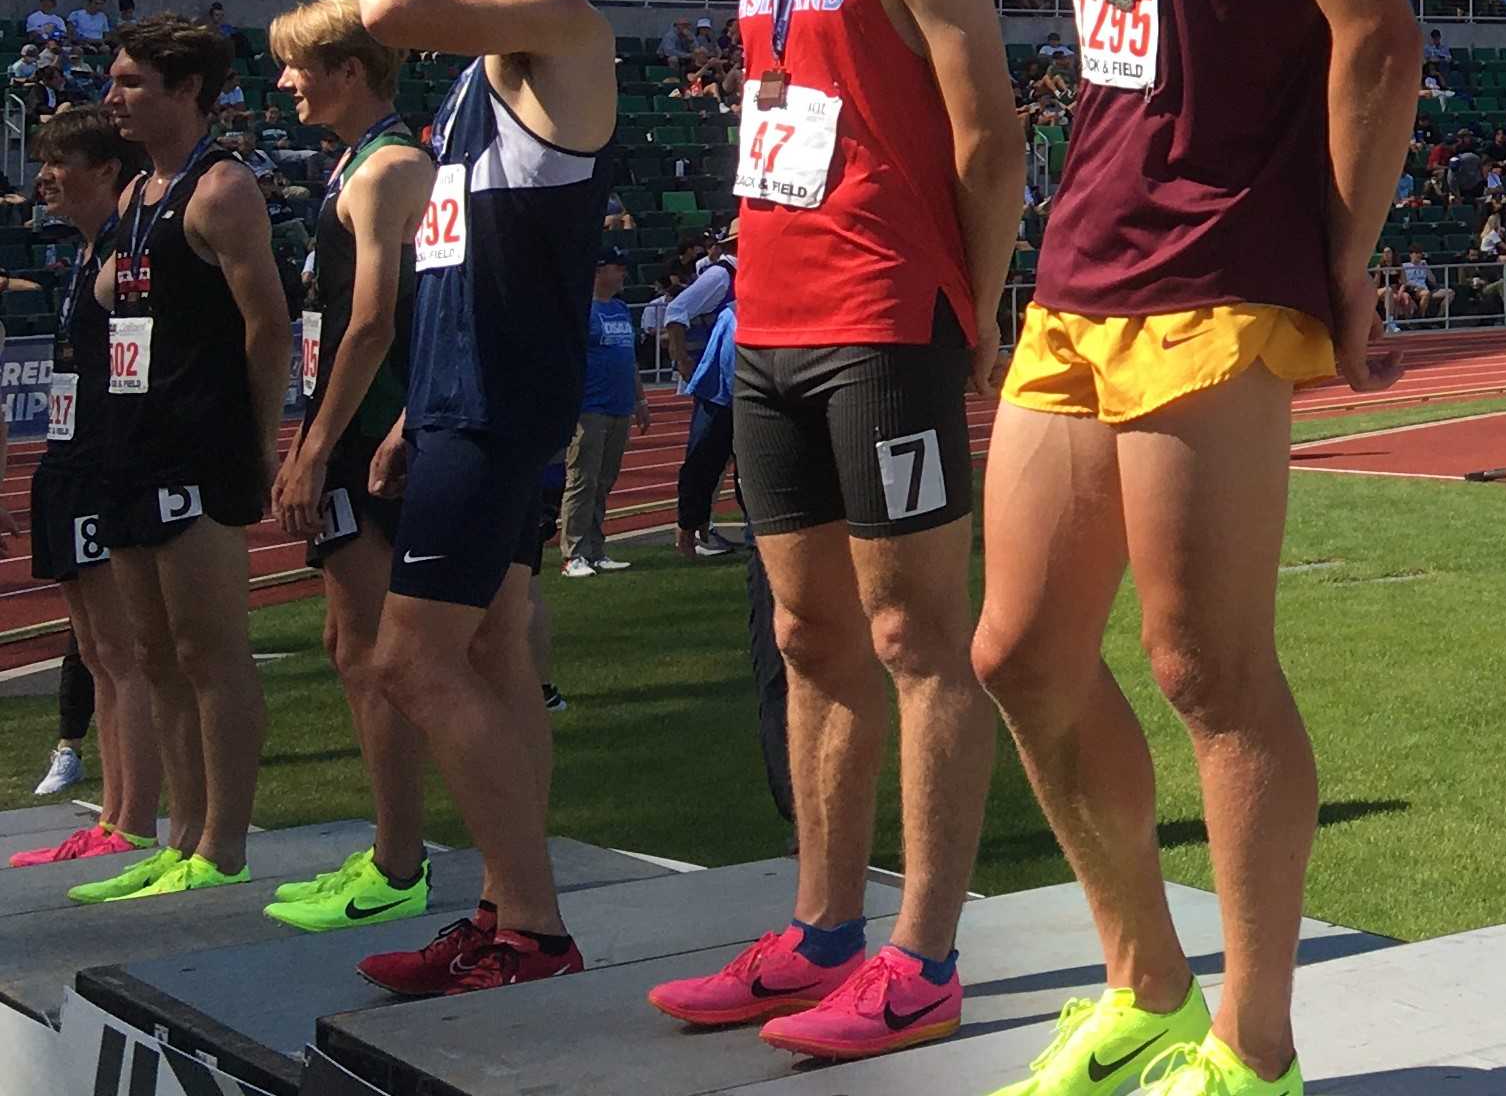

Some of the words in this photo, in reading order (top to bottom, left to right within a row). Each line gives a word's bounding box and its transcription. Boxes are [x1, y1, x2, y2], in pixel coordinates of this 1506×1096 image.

[1112, 60, 1143, 78] FIELD
[749, 120, 796, 173] 47
[772, 180, 808, 199] FIELD
[889, 437, 926, 513] 7
[80, 517, 105, 560] 8
